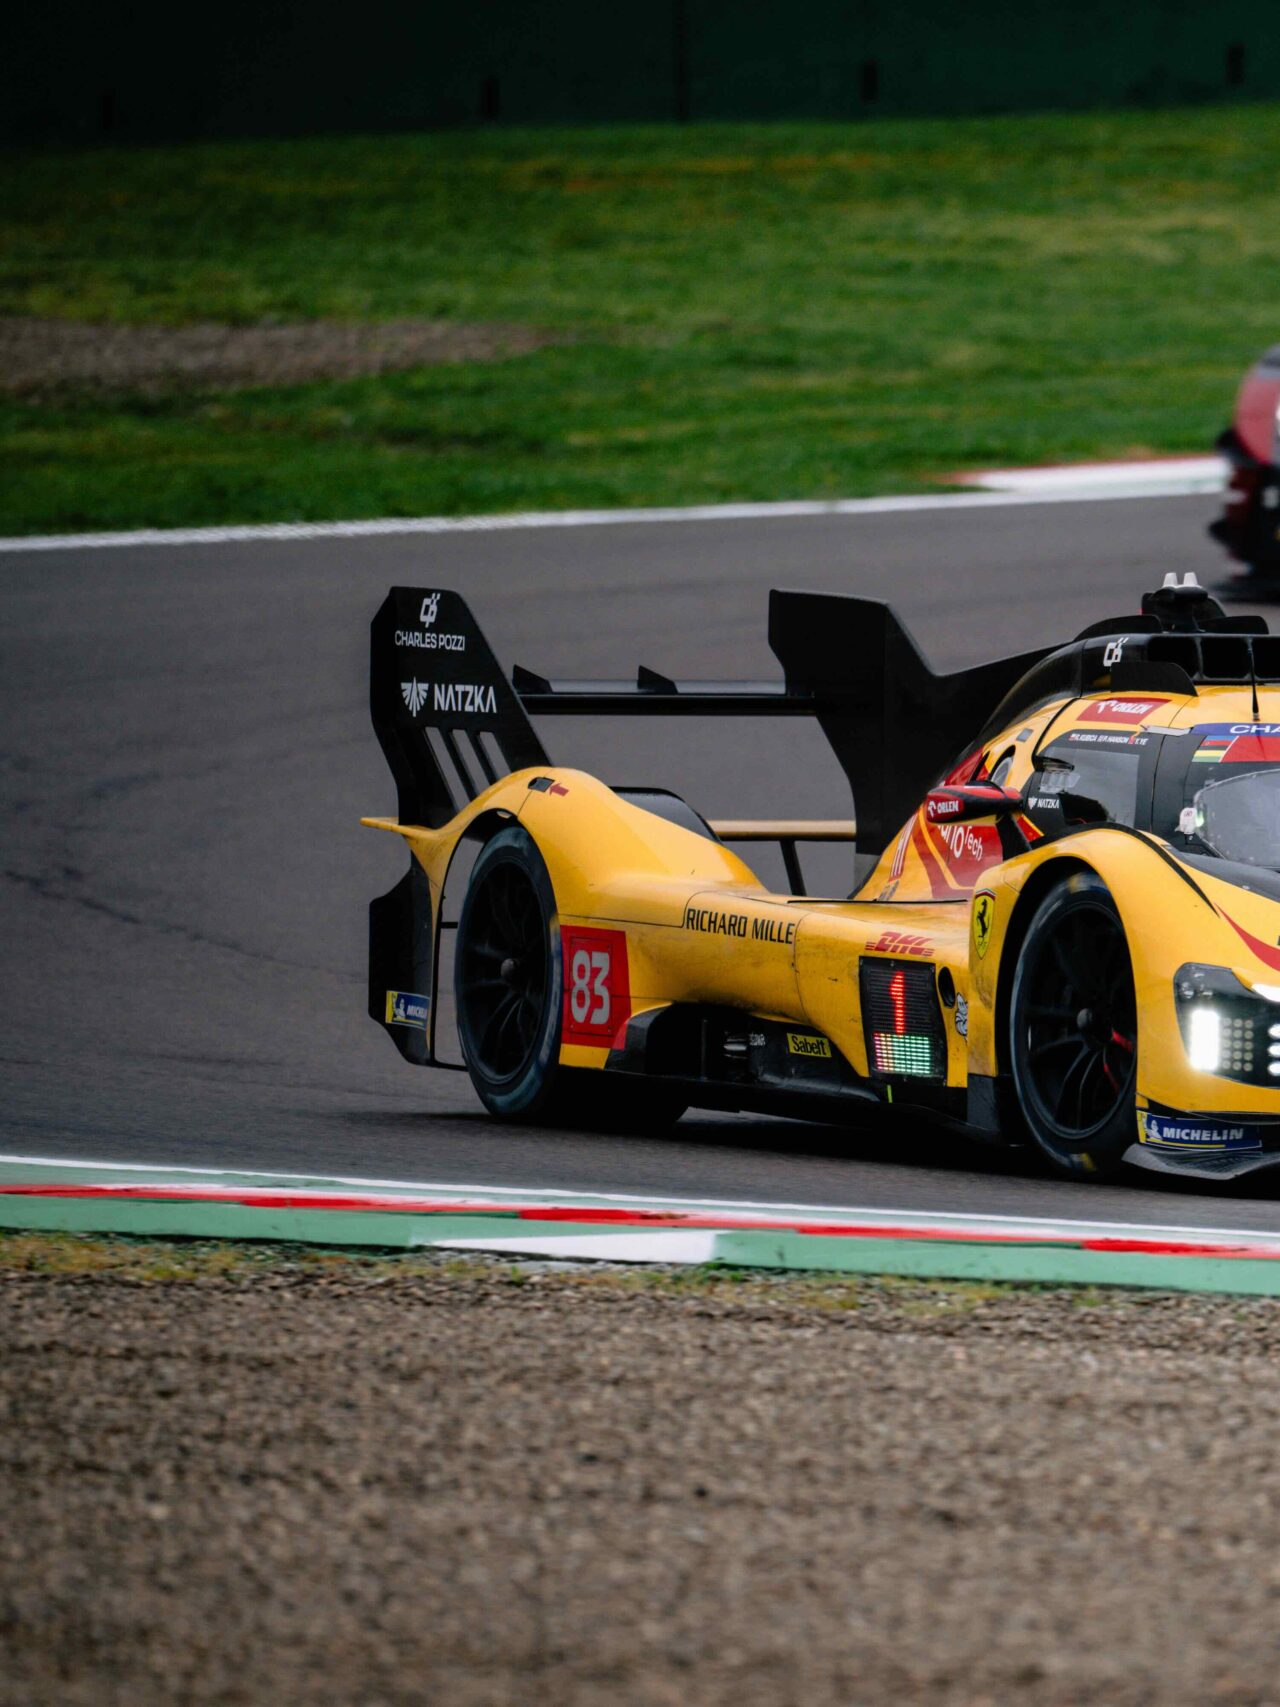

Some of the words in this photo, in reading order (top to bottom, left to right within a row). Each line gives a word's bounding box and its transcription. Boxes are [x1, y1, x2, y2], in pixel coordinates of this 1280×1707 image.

[394, 630, 438, 649] CHARLES
[438, 633, 466, 652] POZZI
[434, 683, 497, 714] NATZKA
[936, 800, 959, 814] ORLEN
[1037, 798, 1060, 809] NATZKA
[684, 907, 748, 938] RICHARD
[751, 917, 796, 945] MILLE
[867, 931, 934, 956] DHL
[571, 949, 611, 1025] 83
[791, 1035, 827, 1056] Sabelt
[1162, 1126, 1244, 1141] MICHELIN
